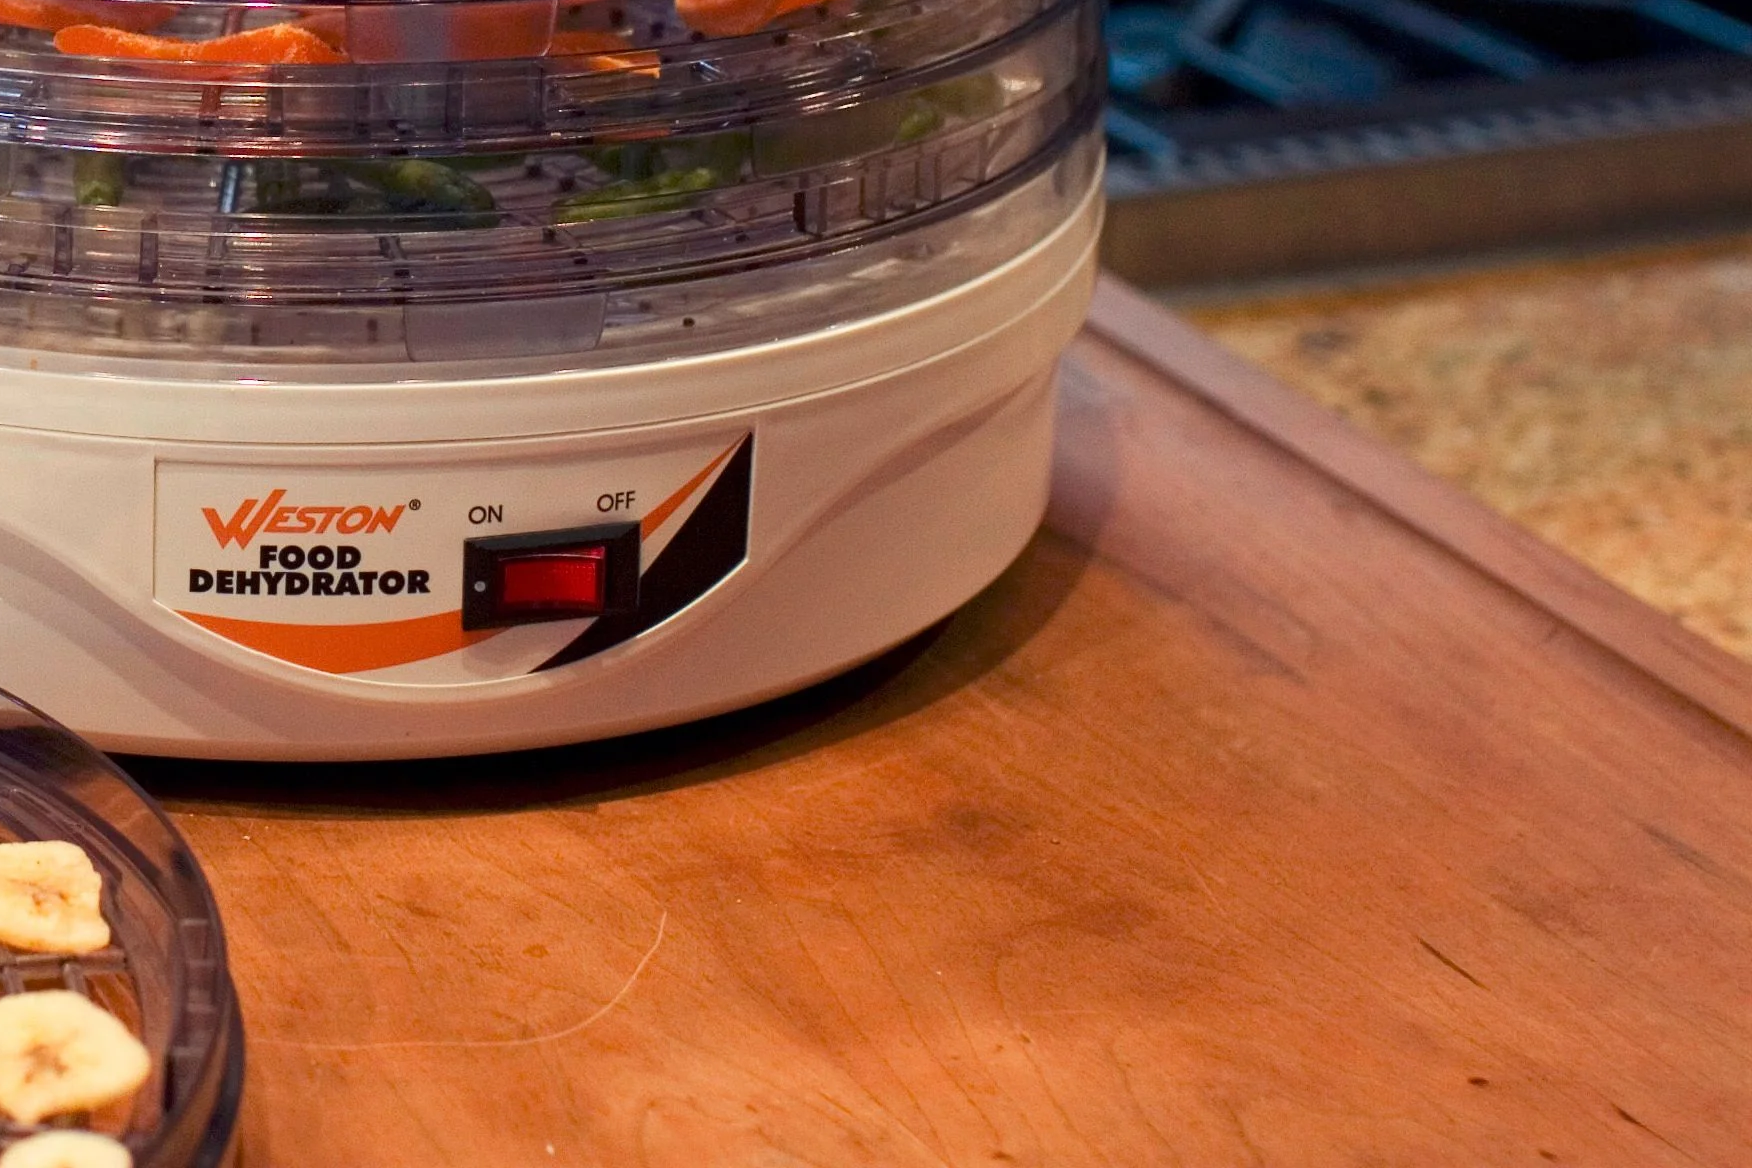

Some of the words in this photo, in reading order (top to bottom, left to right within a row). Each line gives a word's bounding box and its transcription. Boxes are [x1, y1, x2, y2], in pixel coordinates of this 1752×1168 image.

[596, 490, 636, 513] OFF
[468, 505, 503, 525] ON
[259, 545, 361, 570] FOOD
[189, 569, 431, 595] DEHYDRATOR
